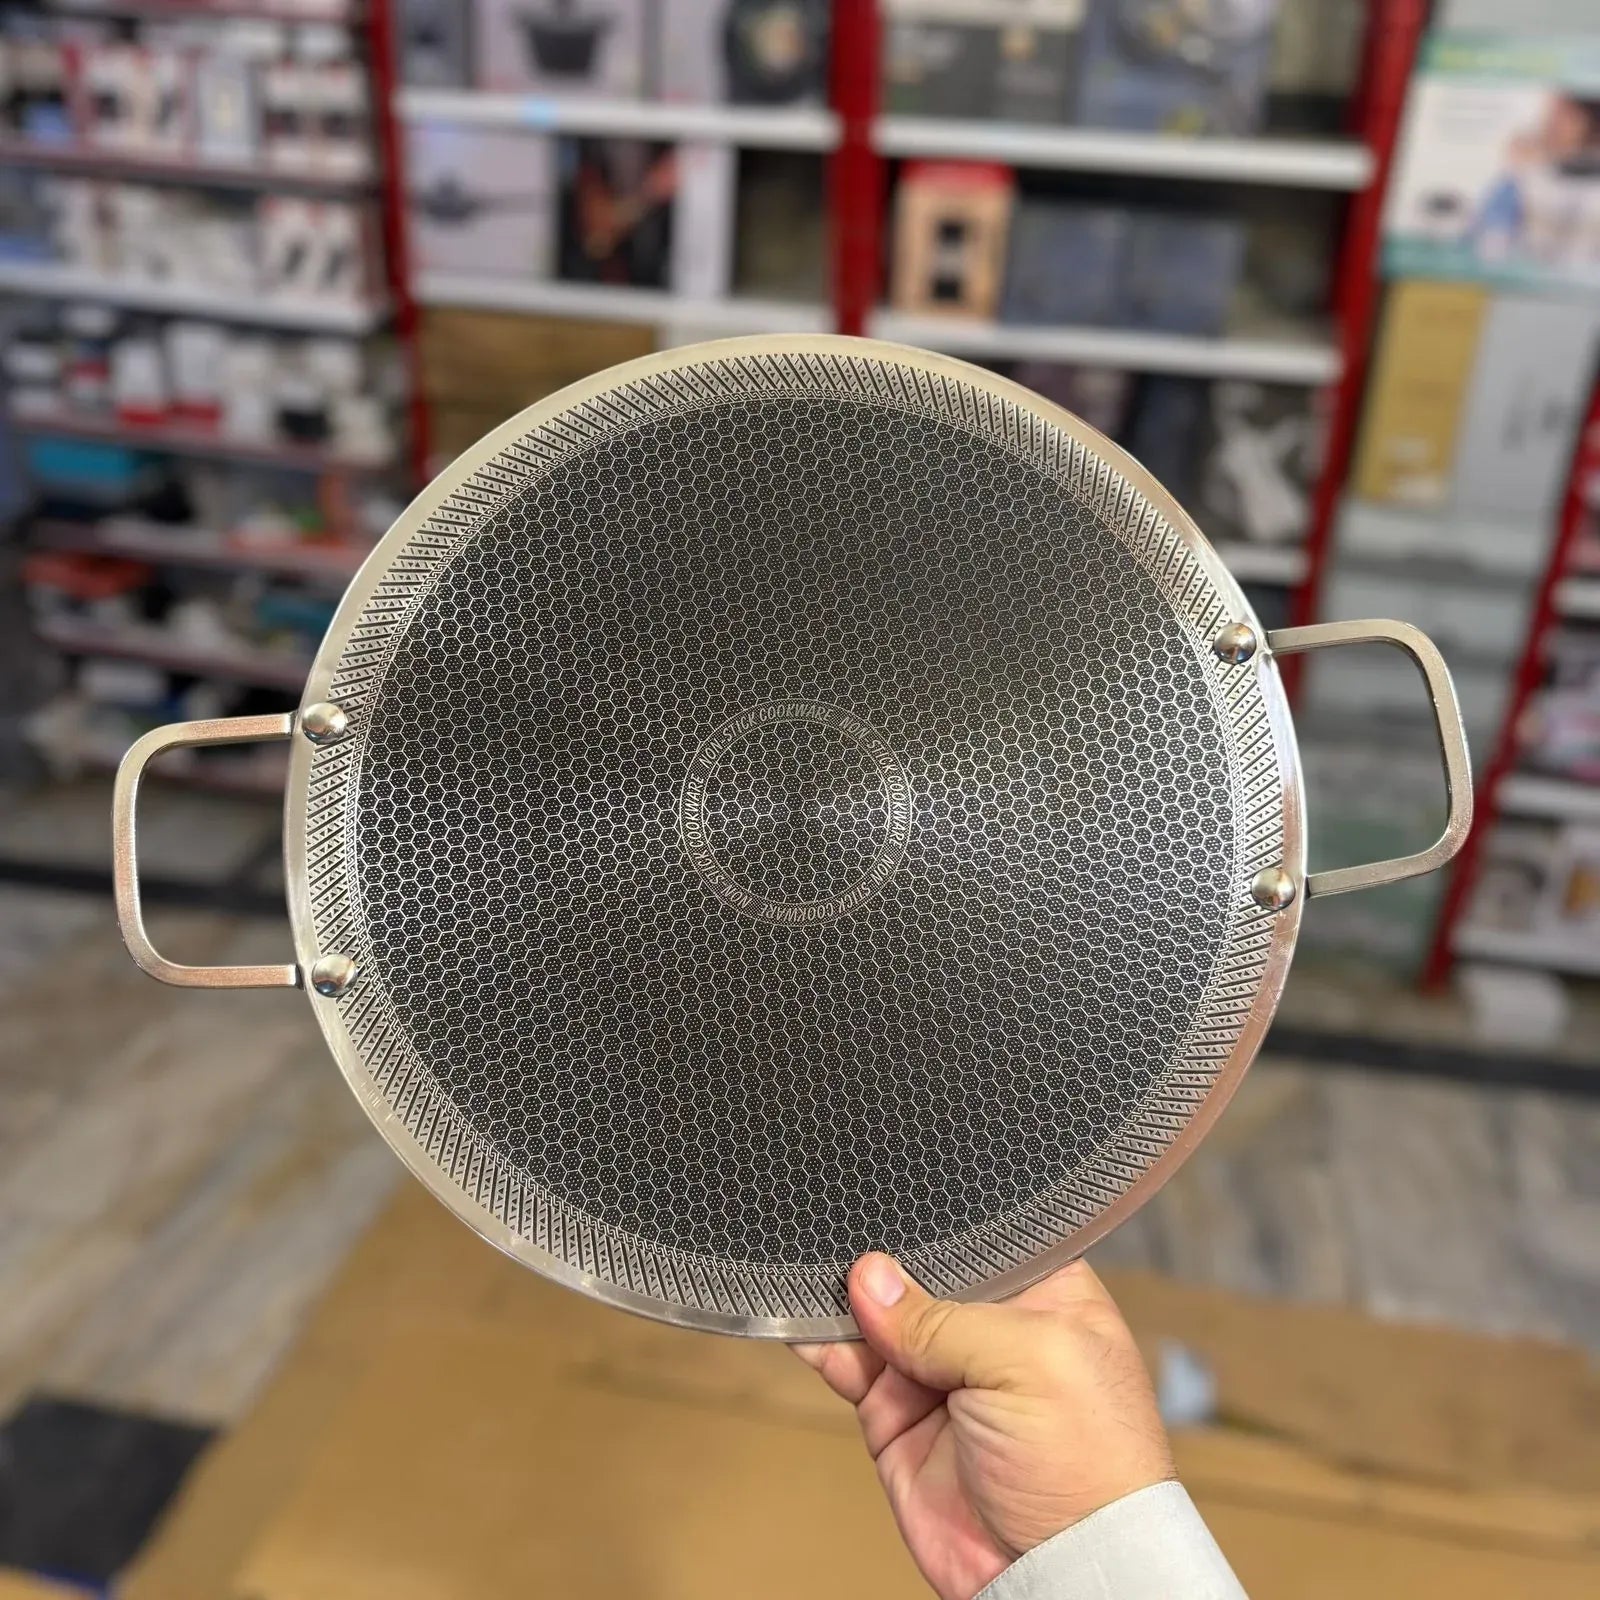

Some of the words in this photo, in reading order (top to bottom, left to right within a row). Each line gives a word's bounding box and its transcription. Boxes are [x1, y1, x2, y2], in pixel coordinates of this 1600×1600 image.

[760, 703, 834, 721] COOKWARE
[684, 773, 704, 848] COOKWARE
[887, 775, 908, 849] COOKWARE
[759, 902, 834, 922] COOKWARE
